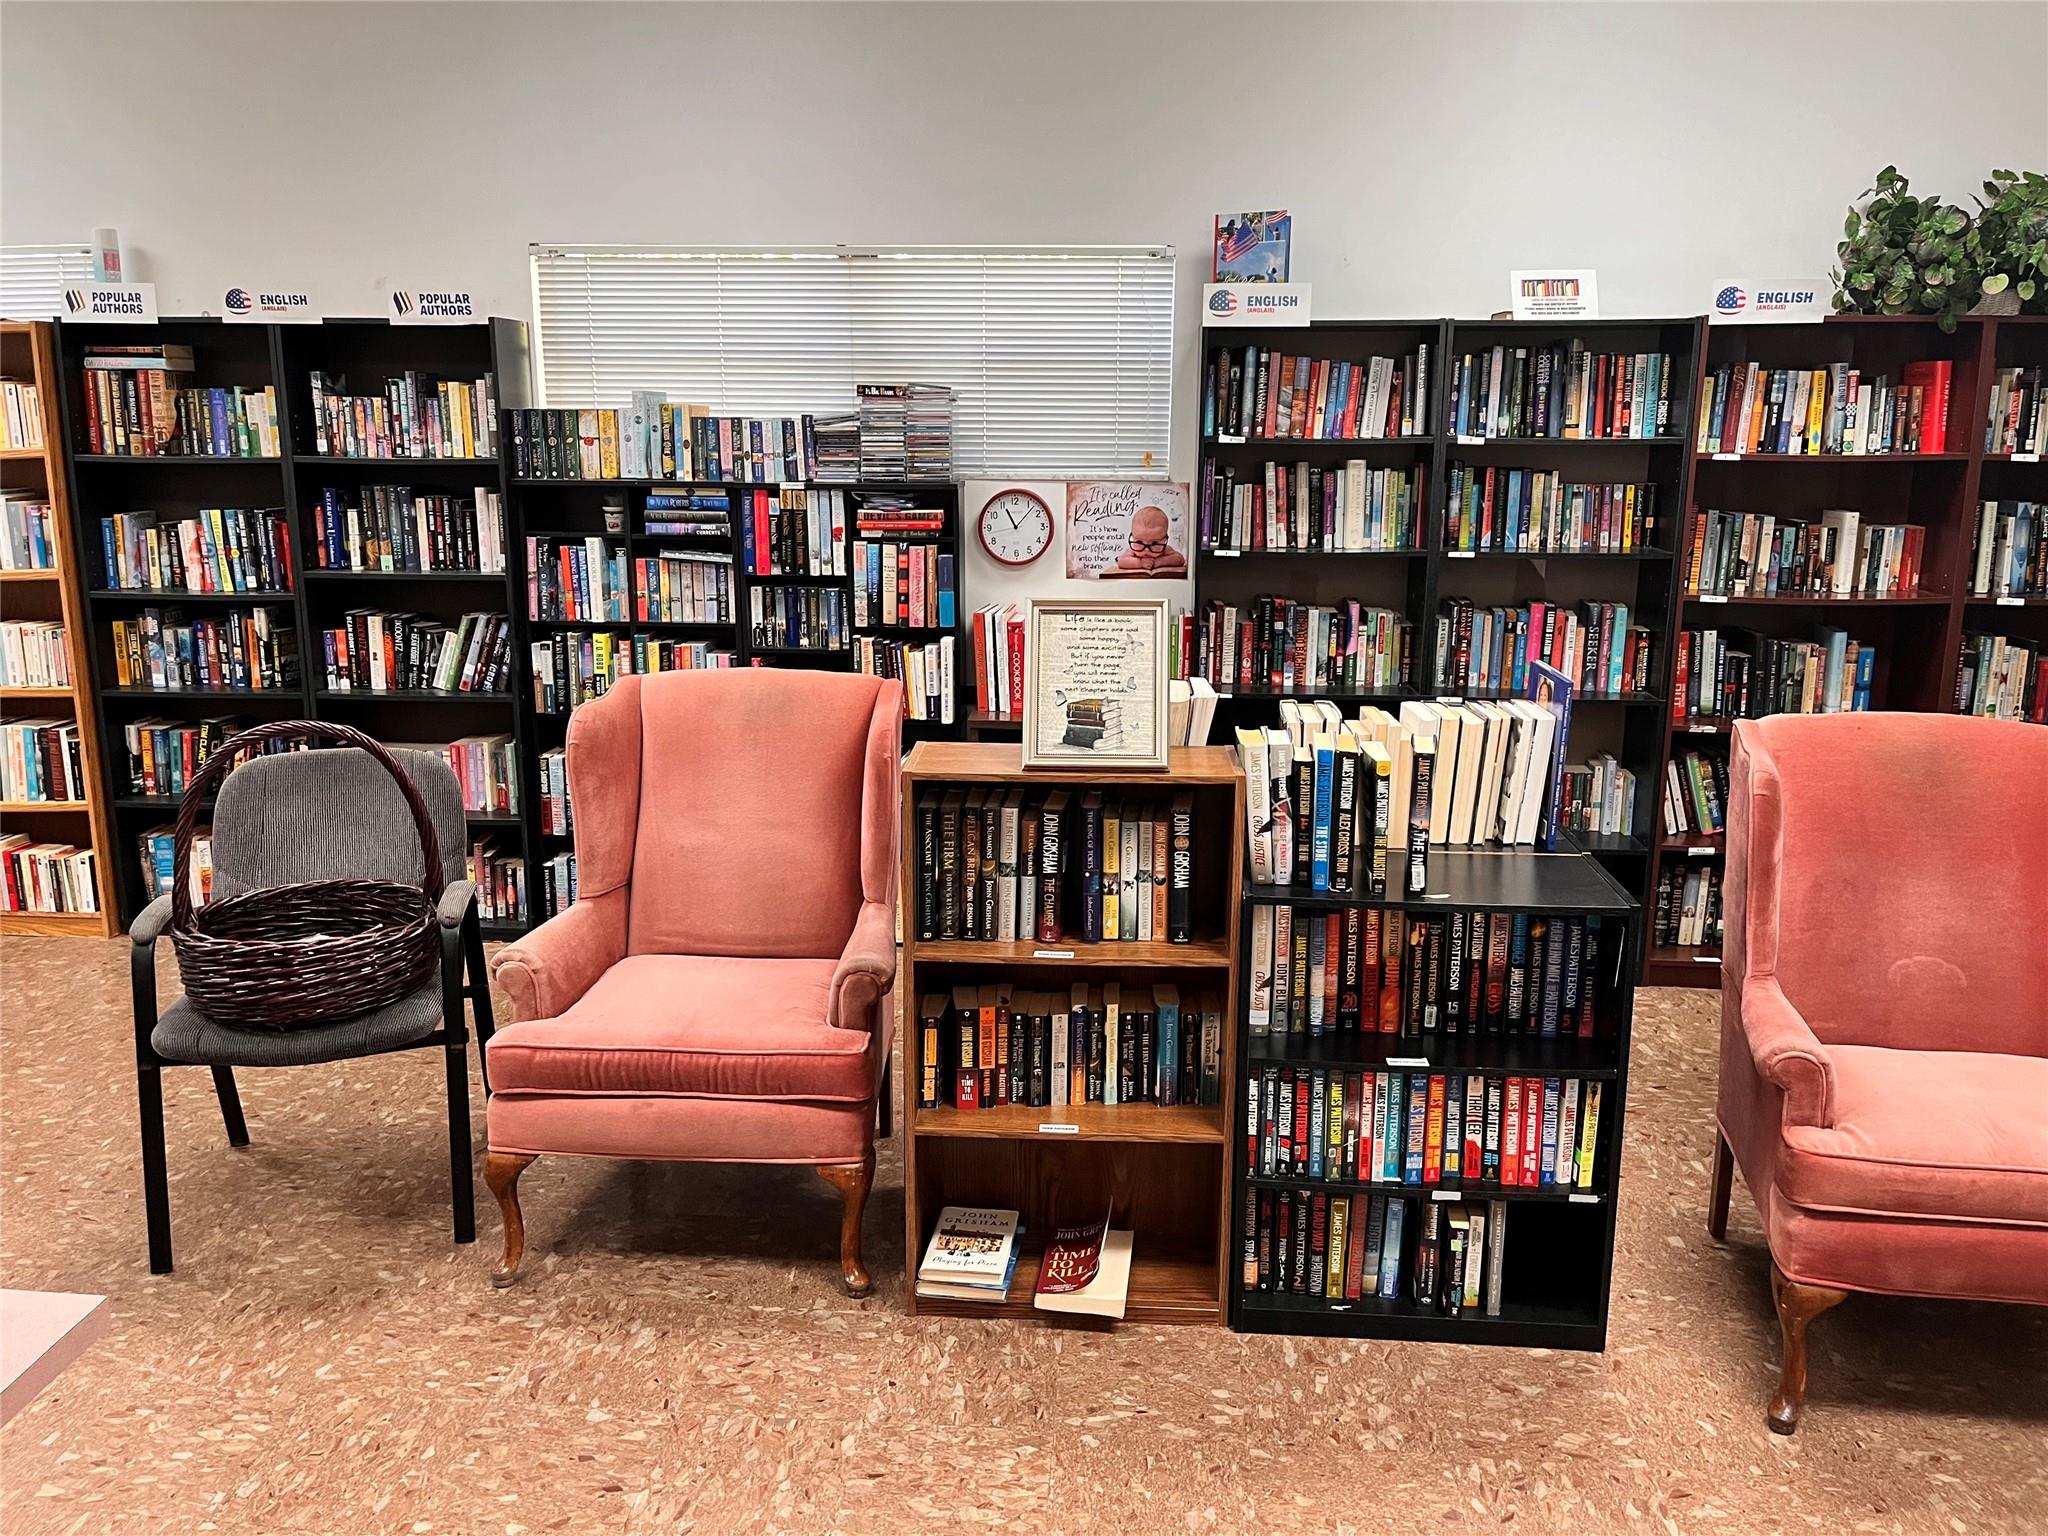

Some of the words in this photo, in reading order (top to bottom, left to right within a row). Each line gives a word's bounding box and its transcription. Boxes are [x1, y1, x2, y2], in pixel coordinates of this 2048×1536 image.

[92, 292, 142, 304] POPULAR
[260, 294, 308, 306] ENGLISH
[419, 293, 470, 305] POPULAR
[1247, 296, 1298, 307] ENGLISH
[1756, 304, 1787, 312] (ANGLAIS)
[1757, 291, 1814, 304] ENGLISH
[92, 303, 143, 315] AUTHORS
[421, 304, 472, 316] AUTHORS
[1537, 355, 1545, 385] COULTER
[1657, 400, 1668, 425] CRISIS
[1011, 497, 1019, 506] 12
[1110, 485, 1142, 500] called
[990, 511, 998, 520] 10
[1026, 501, 1031, 509] 1
[1035, 509, 1041, 518] 2
[1040, 523, 1046, 531] 3
[991, 537, 996, 545] 8
[1001, 546, 1006, 554] 7
[1027, 546, 1032, 554] 5
[1071, 544, 1089, 552] new
[1091, 542, 1123, 555] software
[1014, 549, 1019, 557] 6
[1065, 613, 1084, 624] Life
[1466, 607, 1474, 637] JUSTIN
[395, 622, 403, 652] KOONTZ
[1459, 640, 1467, 656] THE
[1586, 626, 1599, 671] SEEKER
[1013, 652, 1022, 700] COOKBOOK
[1459, 657, 1467, 676] TWELVE
[200, 725, 208, 738] TOM
[198, 739, 207, 764] CLANCY
[1250, 752, 1261, 777] JAMES
[1318, 760, 1330, 782] JAMES
[1342, 757, 1354, 777] JAMES
[1251, 779, 1263, 809] PATTERSON
[1340, 778, 1352, 809] PATTERSON
[1376, 779, 1387, 798] JAMES
[1317, 786, 1329, 822] PATTERSON
[1375, 799, 1387, 828] PATTERSON
[944, 812, 955, 837] THE
[1005, 811, 1014, 824] THE
[1042, 813, 1059, 835] JOHN
[1174, 814, 1190, 836] JOHN
[1253, 815, 1264, 837] CROSS
[1339, 813, 1350, 830] ALEX
[967, 816, 976, 855] PELICAN
[986, 826, 995, 859] SUMMONS
[1316, 826, 1328, 838] THE
[1374, 836, 1386, 846] THE
[924, 828, 932, 866] ASSOCIATE
[1005, 826, 1013, 860] BRETHREN
[1087, 840, 1093, 849] OF
[1254, 839, 1265, 866] JUSTICE
[1315, 840, 1327, 862] STORE
[944, 841, 955, 869] FIRM
[1042, 837, 1058, 873] GRISHAM
[1336, 858, 1348, 873] RUN
[1373, 849, 1386, 880] INJUSTICE
[967, 857, 976, 882] BRIEF
[1174, 851, 1190, 888] GRISHAM
[924, 872, 932, 892] JOHN
[985, 880, 994, 898] JOHN
[1044, 878, 1055, 892] THE
[966, 886, 974, 901] JOHN
[924, 893, 932, 926] GRISHAM
[966, 903, 974, 928] GRISHAM
[985, 900, 994, 929] GRISHAM
[1044, 894, 1054, 927] CHAMBER
[1670, 890, 1682, 928] DETECTIVE
[1551, 921, 1564, 941] FOUR
[1570, 926, 1582, 955] JAMES
[1296, 935, 1306, 958] JAMES
[1549, 943, 1563, 964] BLIND
[1346, 935, 1356, 985] PATTERSON
[1294, 960, 1306, 996] PATTERSON
[1385, 960, 1400, 990] BURN
[1547, 965, 1560, 983] MICE
[1566, 956, 1580, 1008] PATTERSON
[1585, 977, 1593, 998] CRAZY
[1276, 989, 1287, 1013] BLINK
[961, 1079, 974, 1087] TIME
[1391, 1079, 1400, 1104] JAMES
[962, 1093, 973, 1101] KILL
[1330, 1083, 1342, 1106] JAMES
[1506, 1085, 1519, 1109] JAMES
[1467, 1094, 1482, 1135] THRILLER
[1330, 1107, 1341, 1144] PATTERSON
[1389, 1105, 1399, 1149] PATTERSON
[1506, 1112, 1518, 1154] PATTERSON
[944, 1217, 1010, 1227] GRISHAM
[960, 1211, 998, 1220] JOHN
[1312, 1211, 1325, 1229] BAD
[1056, 1231, 1080, 1240] JOHN
[1311, 1230, 1324, 1252] WOLF
[932, 1256, 961, 1266] Playing
[963, 1257, 976, 1267] for
[1049, 1260, 1074, 1269] TO
[1053, 1247, 1094, 1261] TIME
[1047, 1265, 1088, 1284] KILL
